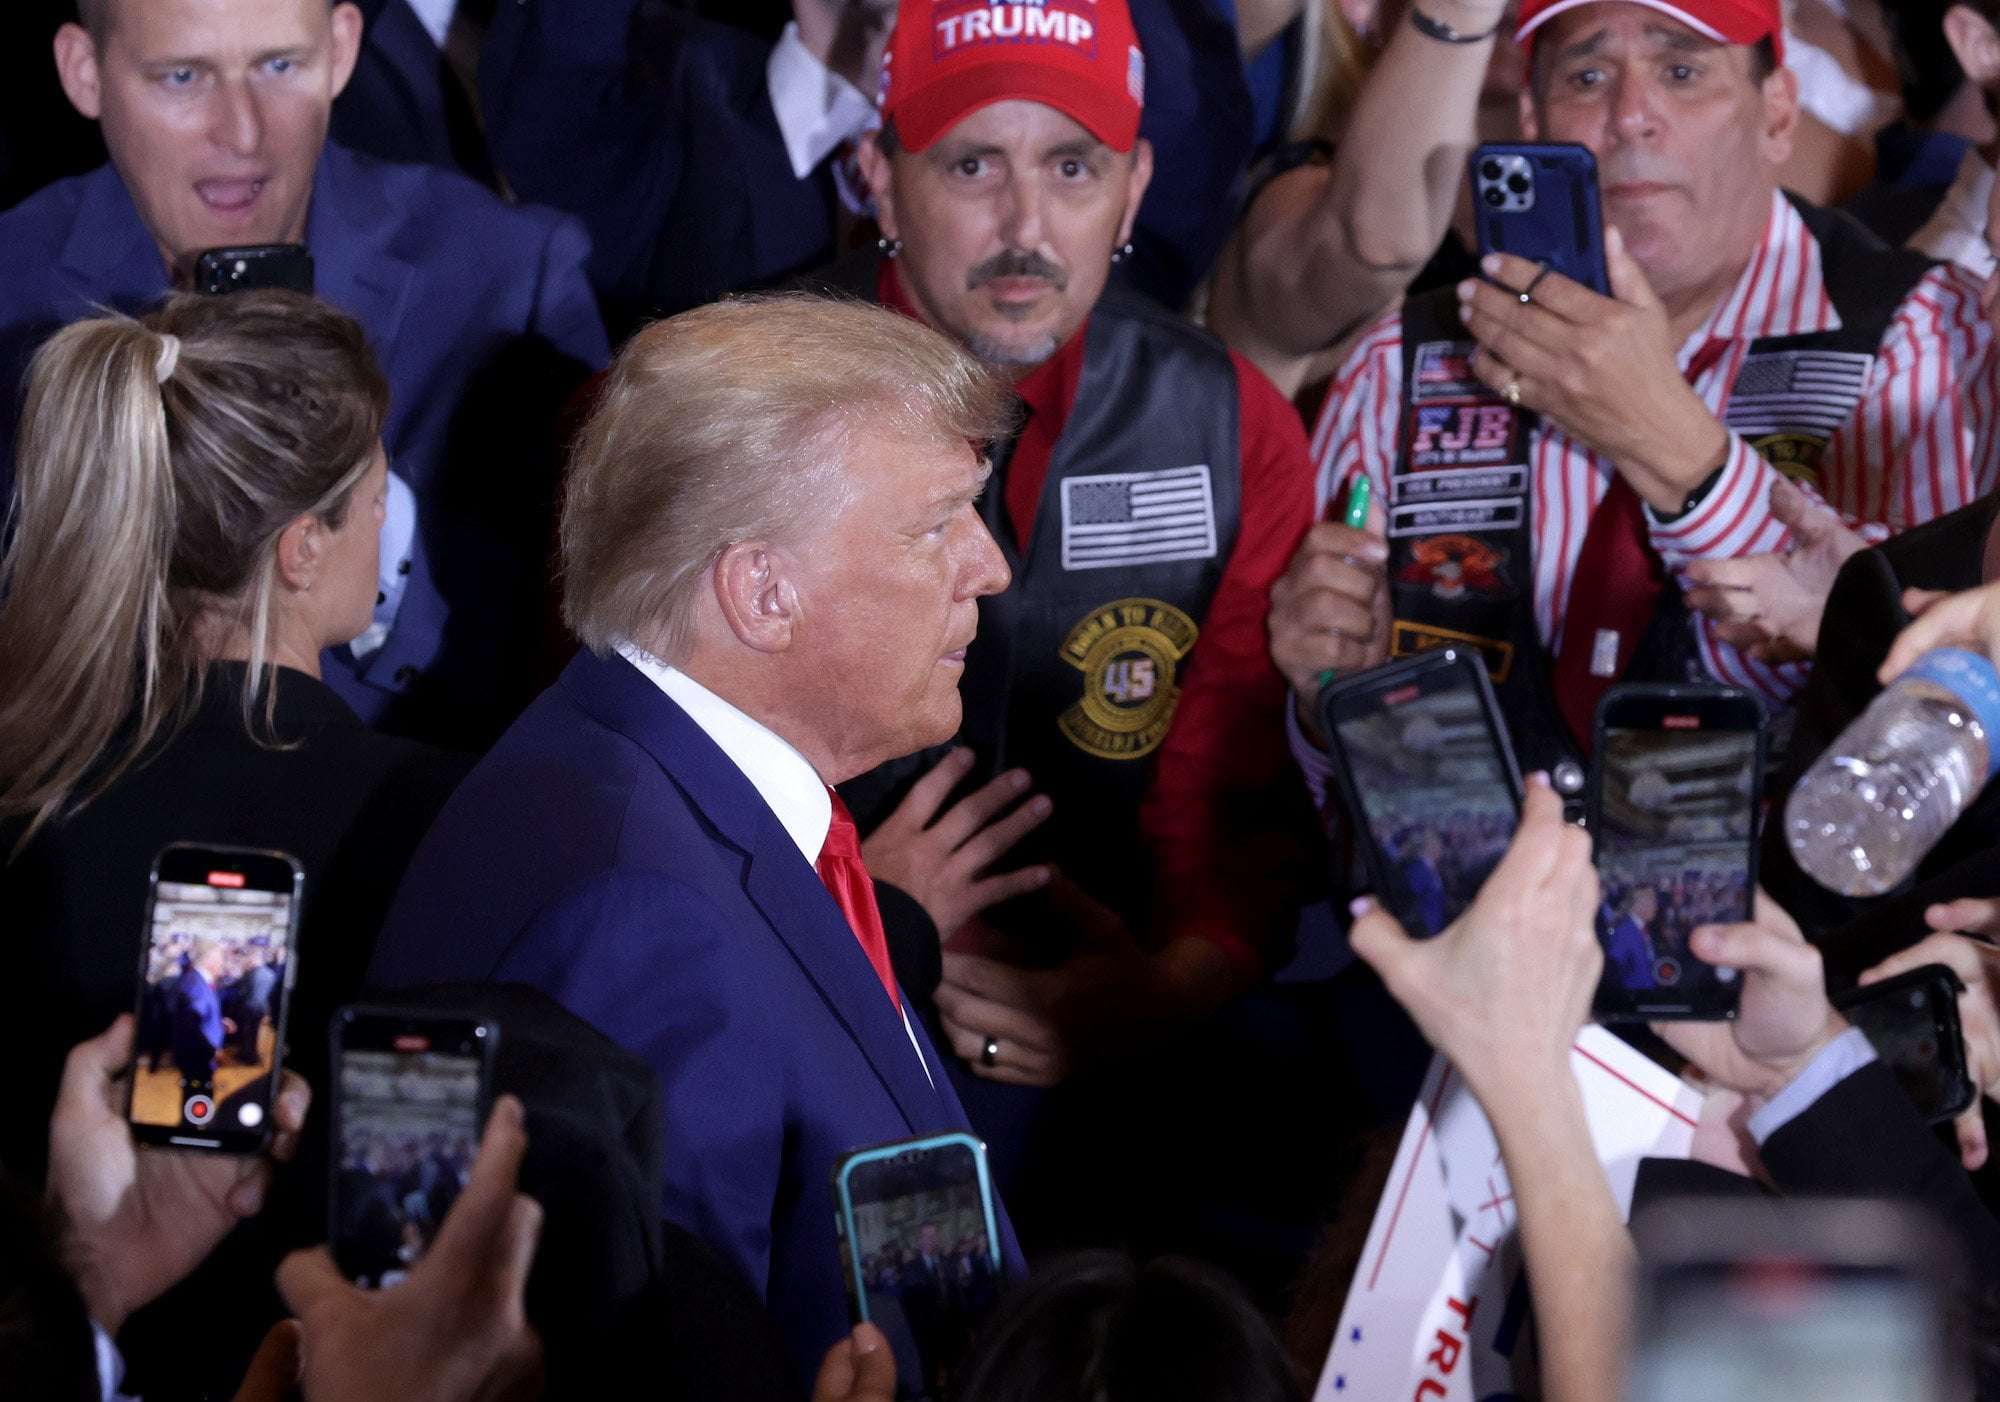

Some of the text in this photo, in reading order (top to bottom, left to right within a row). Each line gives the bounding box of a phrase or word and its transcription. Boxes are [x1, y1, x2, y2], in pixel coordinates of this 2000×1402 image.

[936, 6, 1093, 48] TRUMP
[1413, 406, 1511, 452] FJB
[1104, 658, 1153, 702] 45
